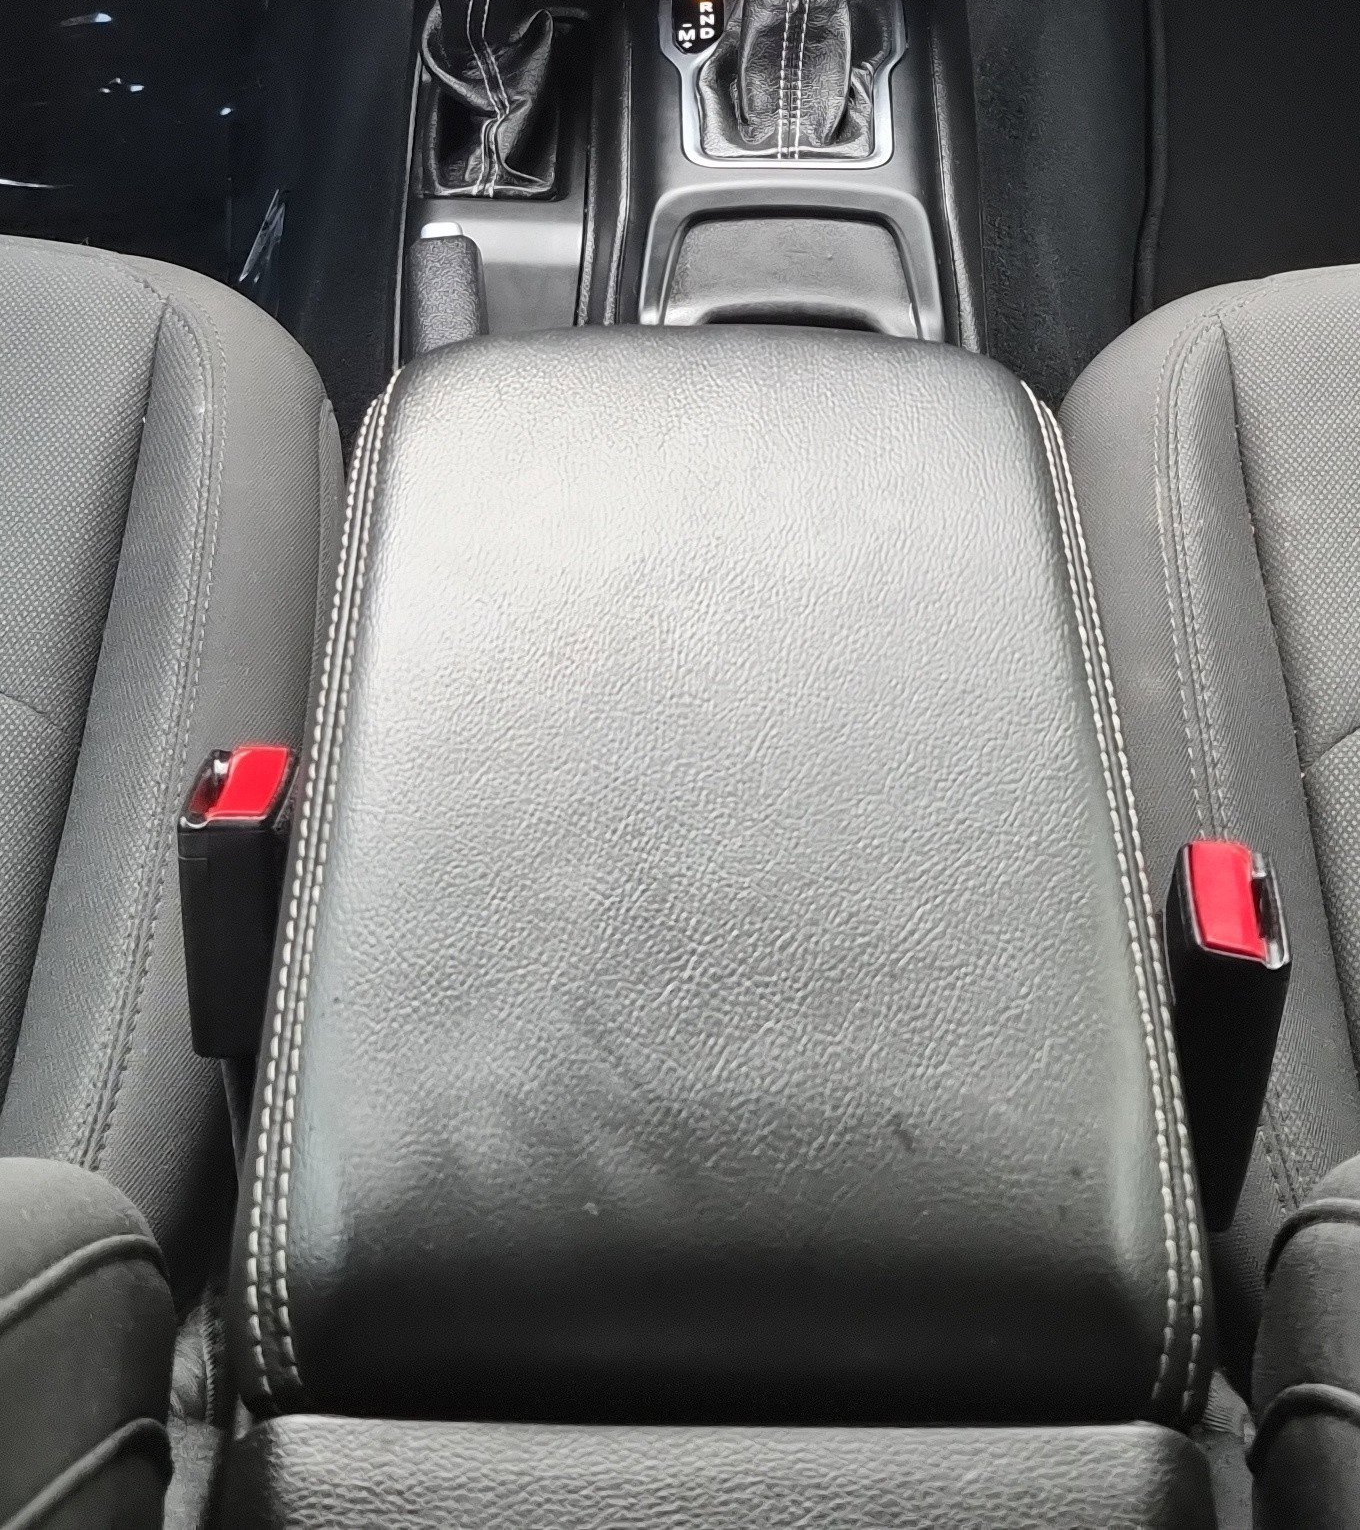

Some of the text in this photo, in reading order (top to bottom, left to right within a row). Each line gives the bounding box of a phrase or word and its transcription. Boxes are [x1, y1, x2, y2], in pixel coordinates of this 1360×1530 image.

[700, 1, 714, 13] R
[700, 14, 715, 25] N
[700, 27, 715, 40] D
